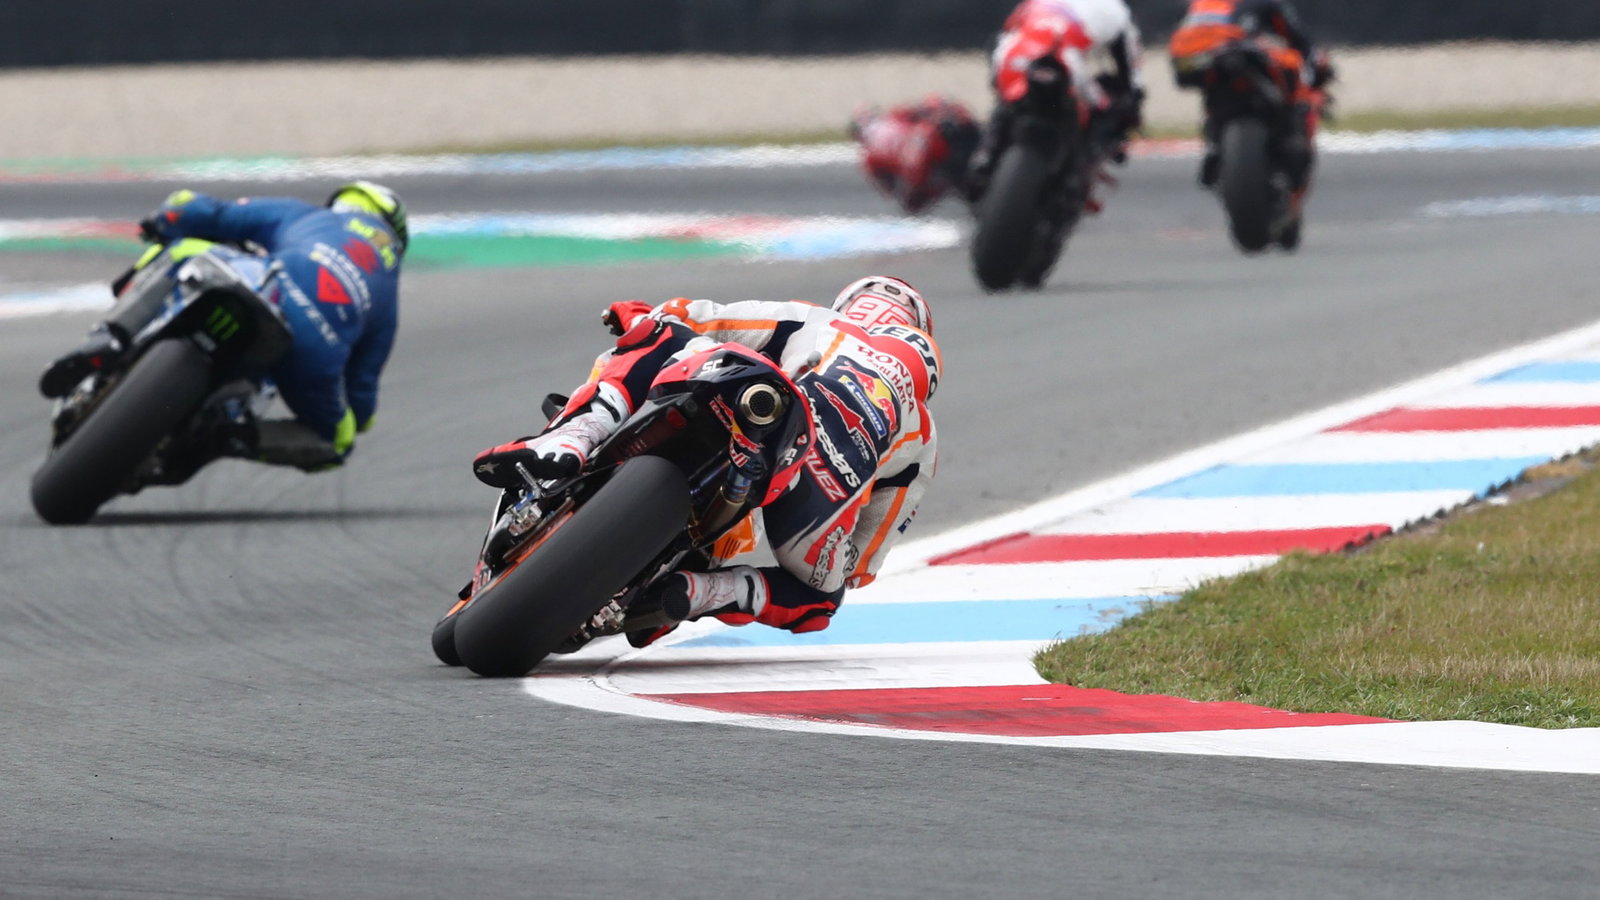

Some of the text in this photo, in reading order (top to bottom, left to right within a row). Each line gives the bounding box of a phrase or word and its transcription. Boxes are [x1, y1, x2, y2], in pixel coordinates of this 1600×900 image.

[700, 358, 723, 375] SC
[857, 345, 915, 415] HONDA
[855, 390, 884, 432] MICHELIN
